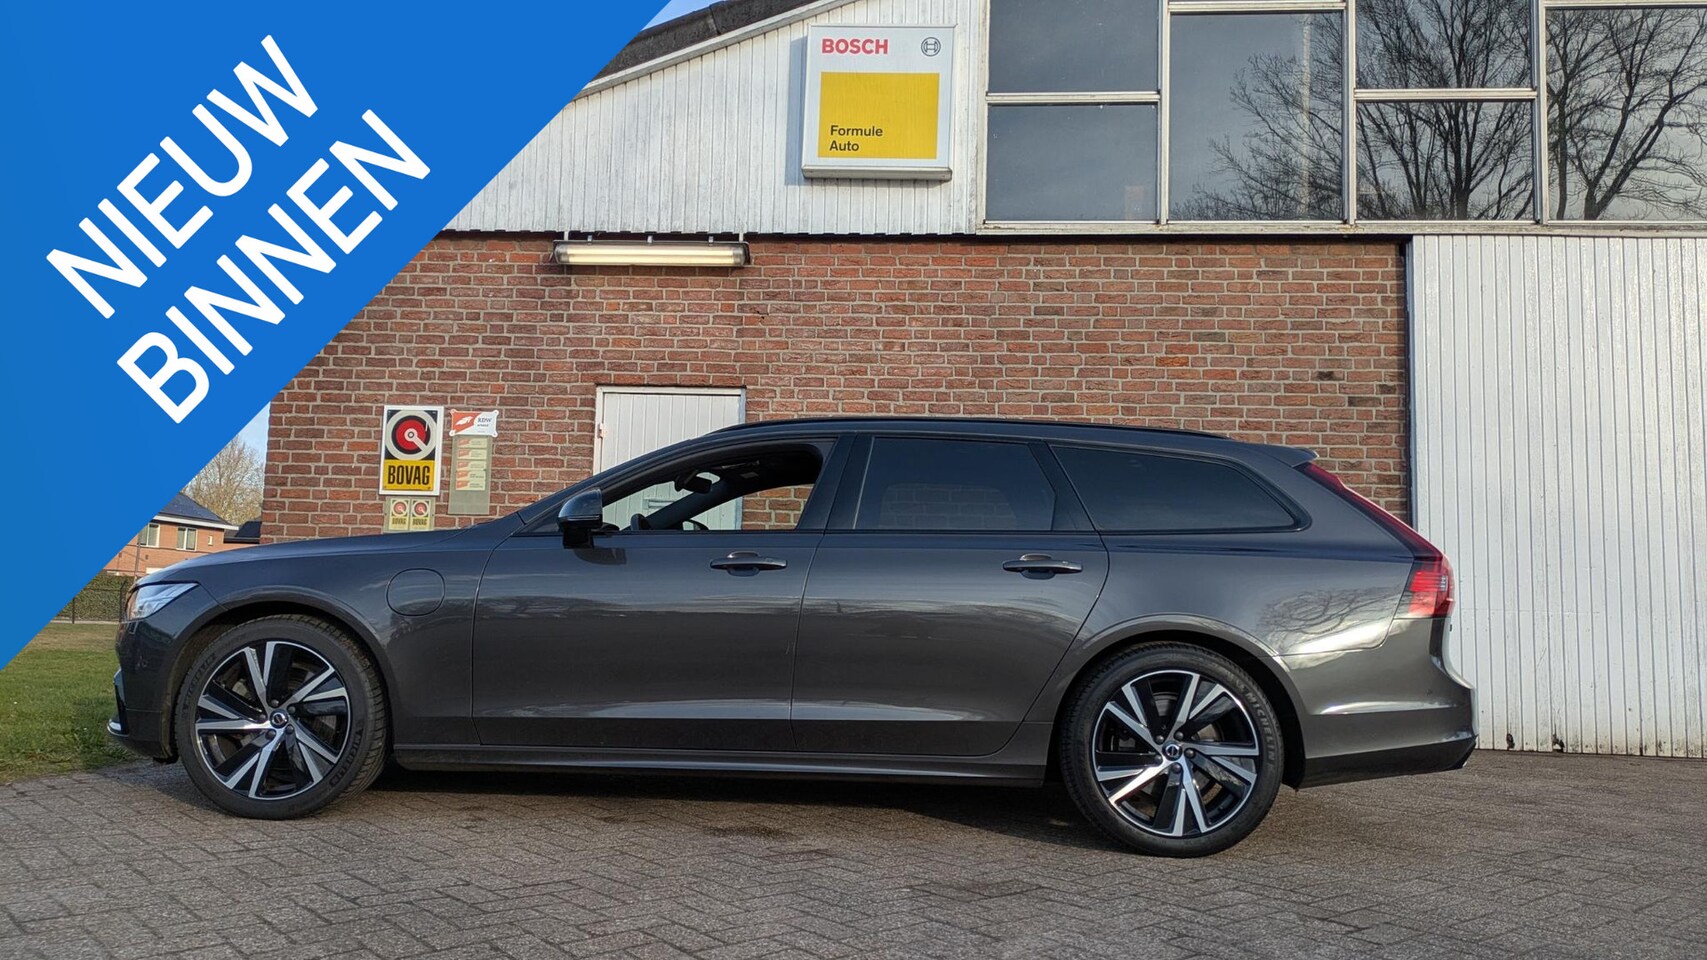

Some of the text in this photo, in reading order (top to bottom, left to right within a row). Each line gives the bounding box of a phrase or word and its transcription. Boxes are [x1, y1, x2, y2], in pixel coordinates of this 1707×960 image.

[822, 39, 889, 54] BOSCH
[830, 125, 884, 137] Formule
[829, 140, 860, 152] Auto
[387, 465, 431, 485] BOVAG
[392, 517, 407, 525] BOVAG
[412, 518, 427, 526] BOVAG
[1245, 691, 1276, 761] MICHELIN
